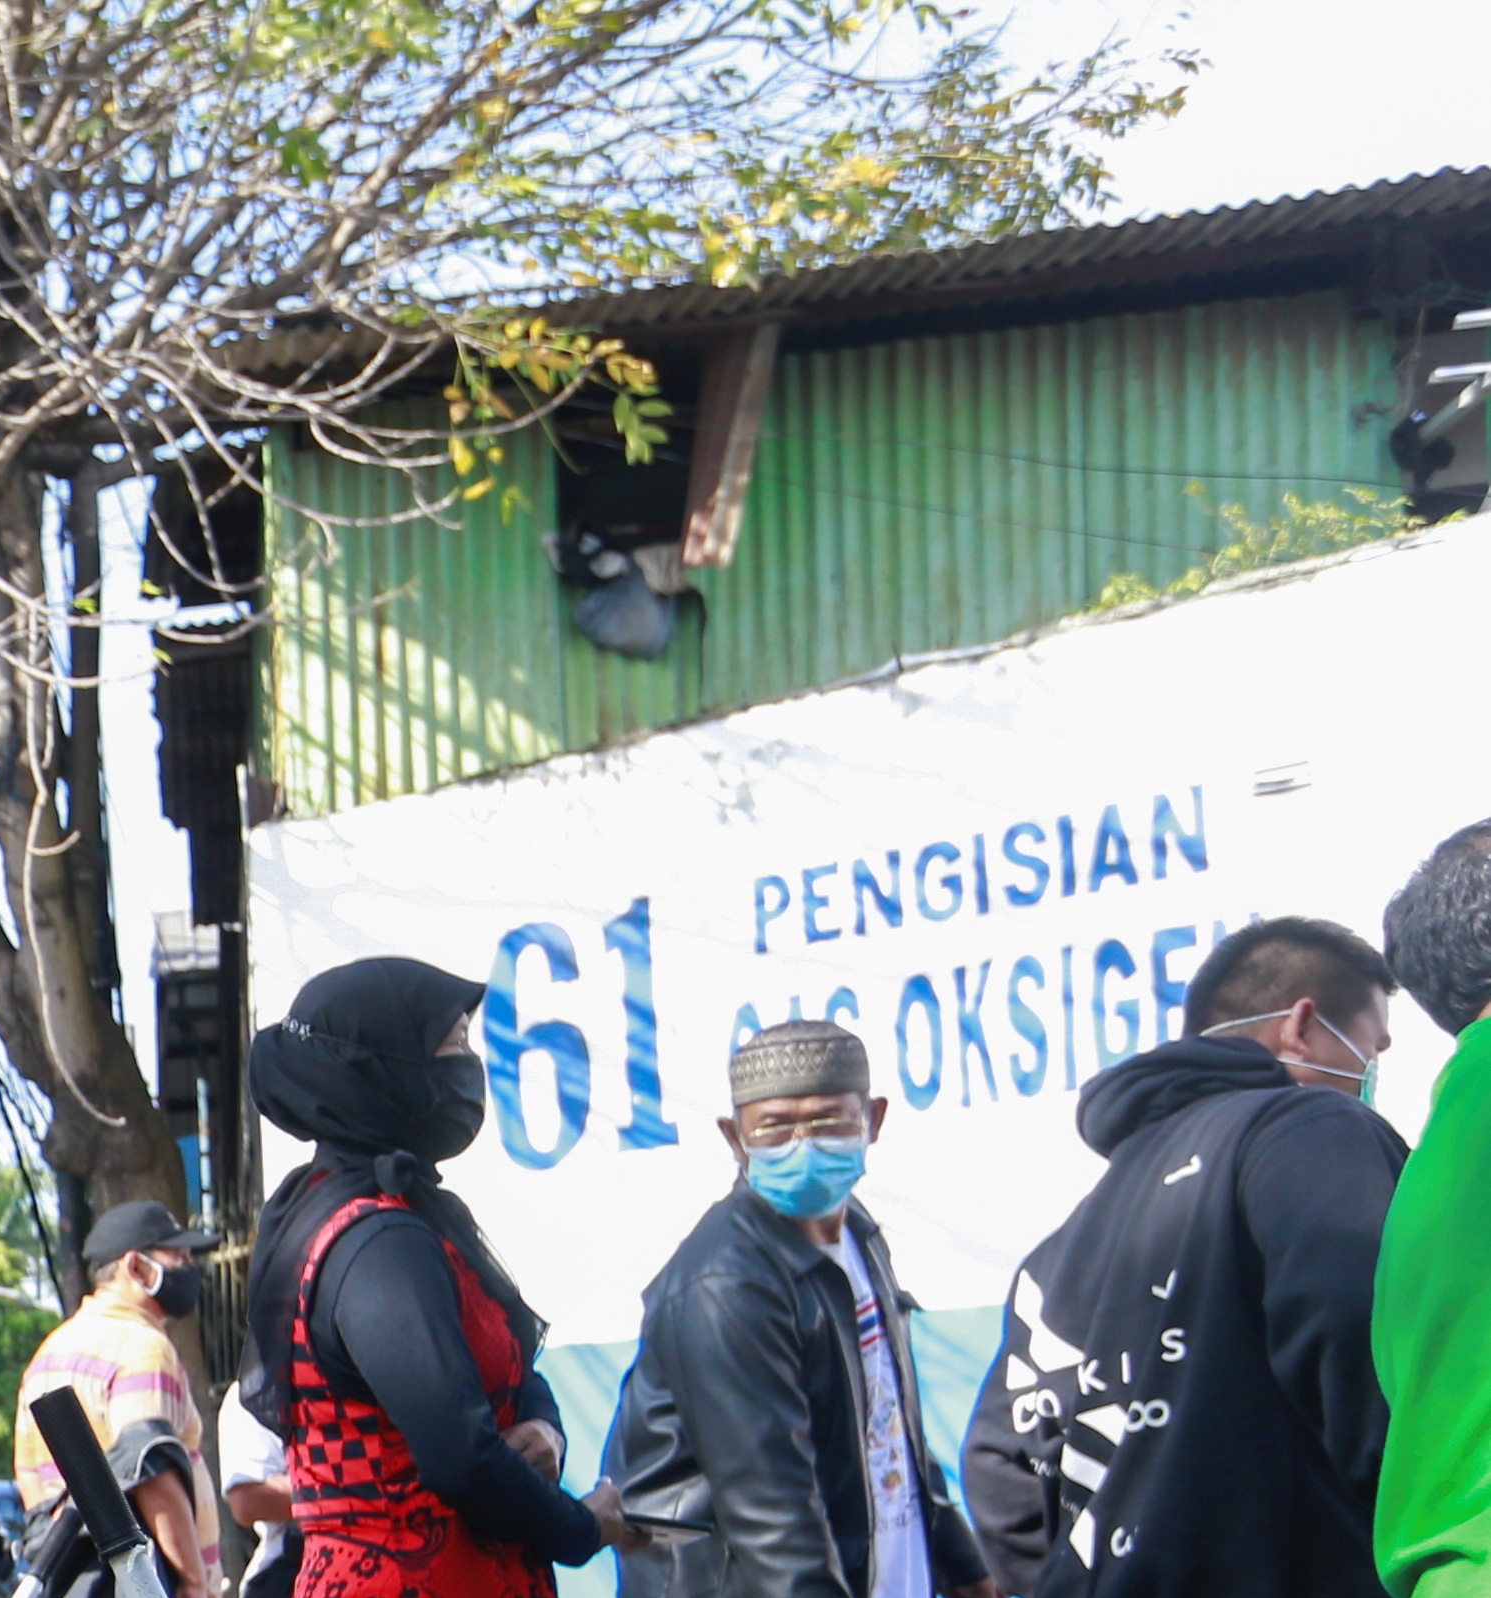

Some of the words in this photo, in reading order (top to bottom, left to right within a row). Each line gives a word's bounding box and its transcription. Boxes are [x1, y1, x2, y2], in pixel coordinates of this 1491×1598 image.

[753, 784, 1208, 954] PENGISIAN
[482, 896, 680, 1171] 61
[895, 911, 1260, 1111] OKSIGE
